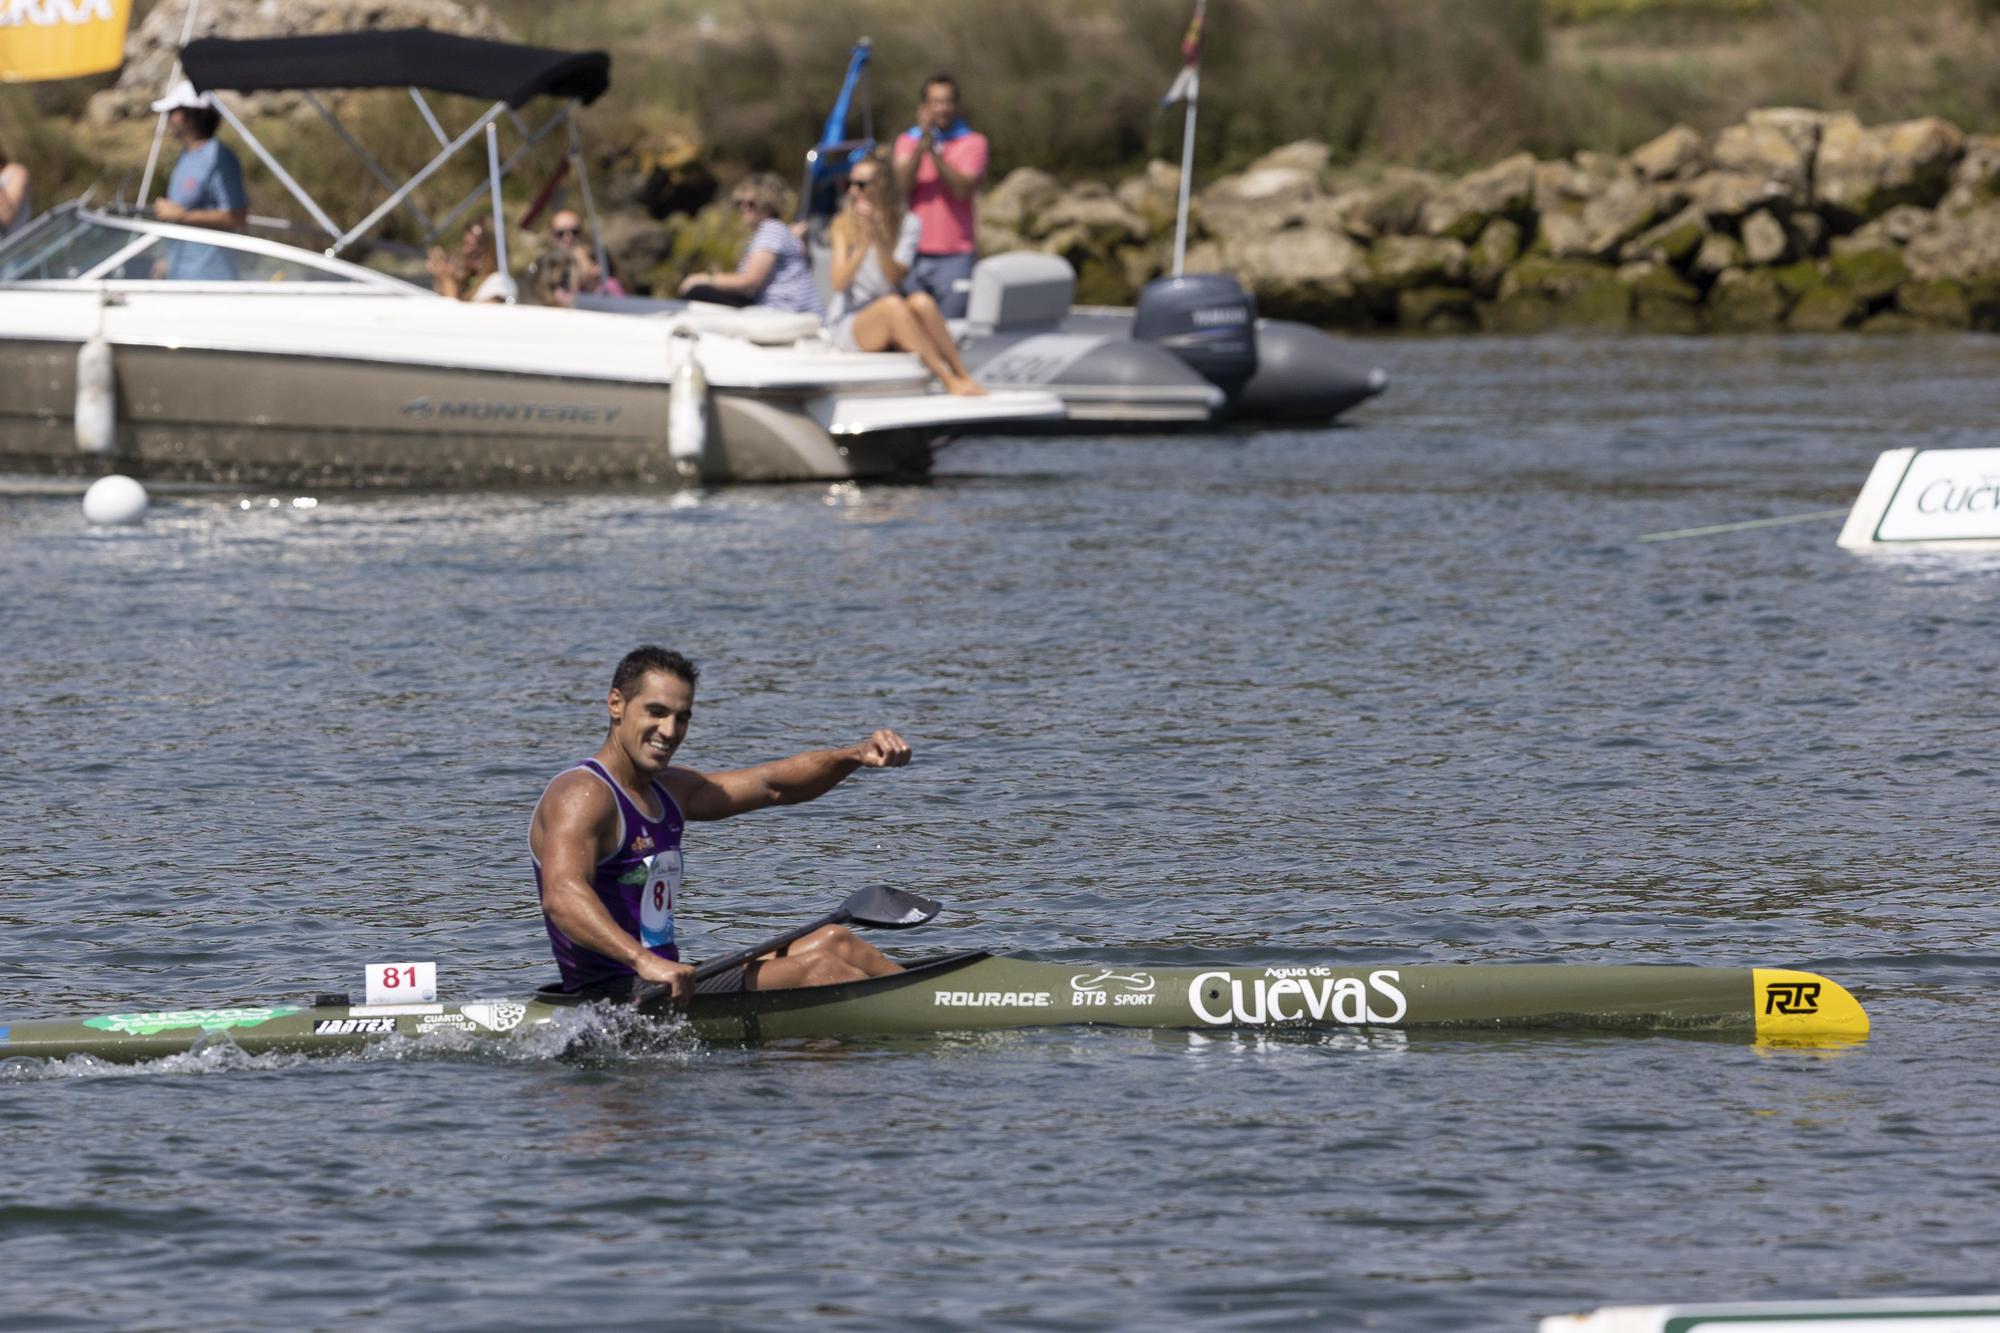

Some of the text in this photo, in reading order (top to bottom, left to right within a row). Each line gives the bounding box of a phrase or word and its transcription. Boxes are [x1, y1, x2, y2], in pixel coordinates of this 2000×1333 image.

[437, 400, 622, 425] MONTEREY
[382, 966, 417, 989] 81
[1264, 966, 1332, 979] Agua de
[1071, 991, 1156, 1006] BTB SPORT
[423, 1013, 465, 1023] CUARTO
